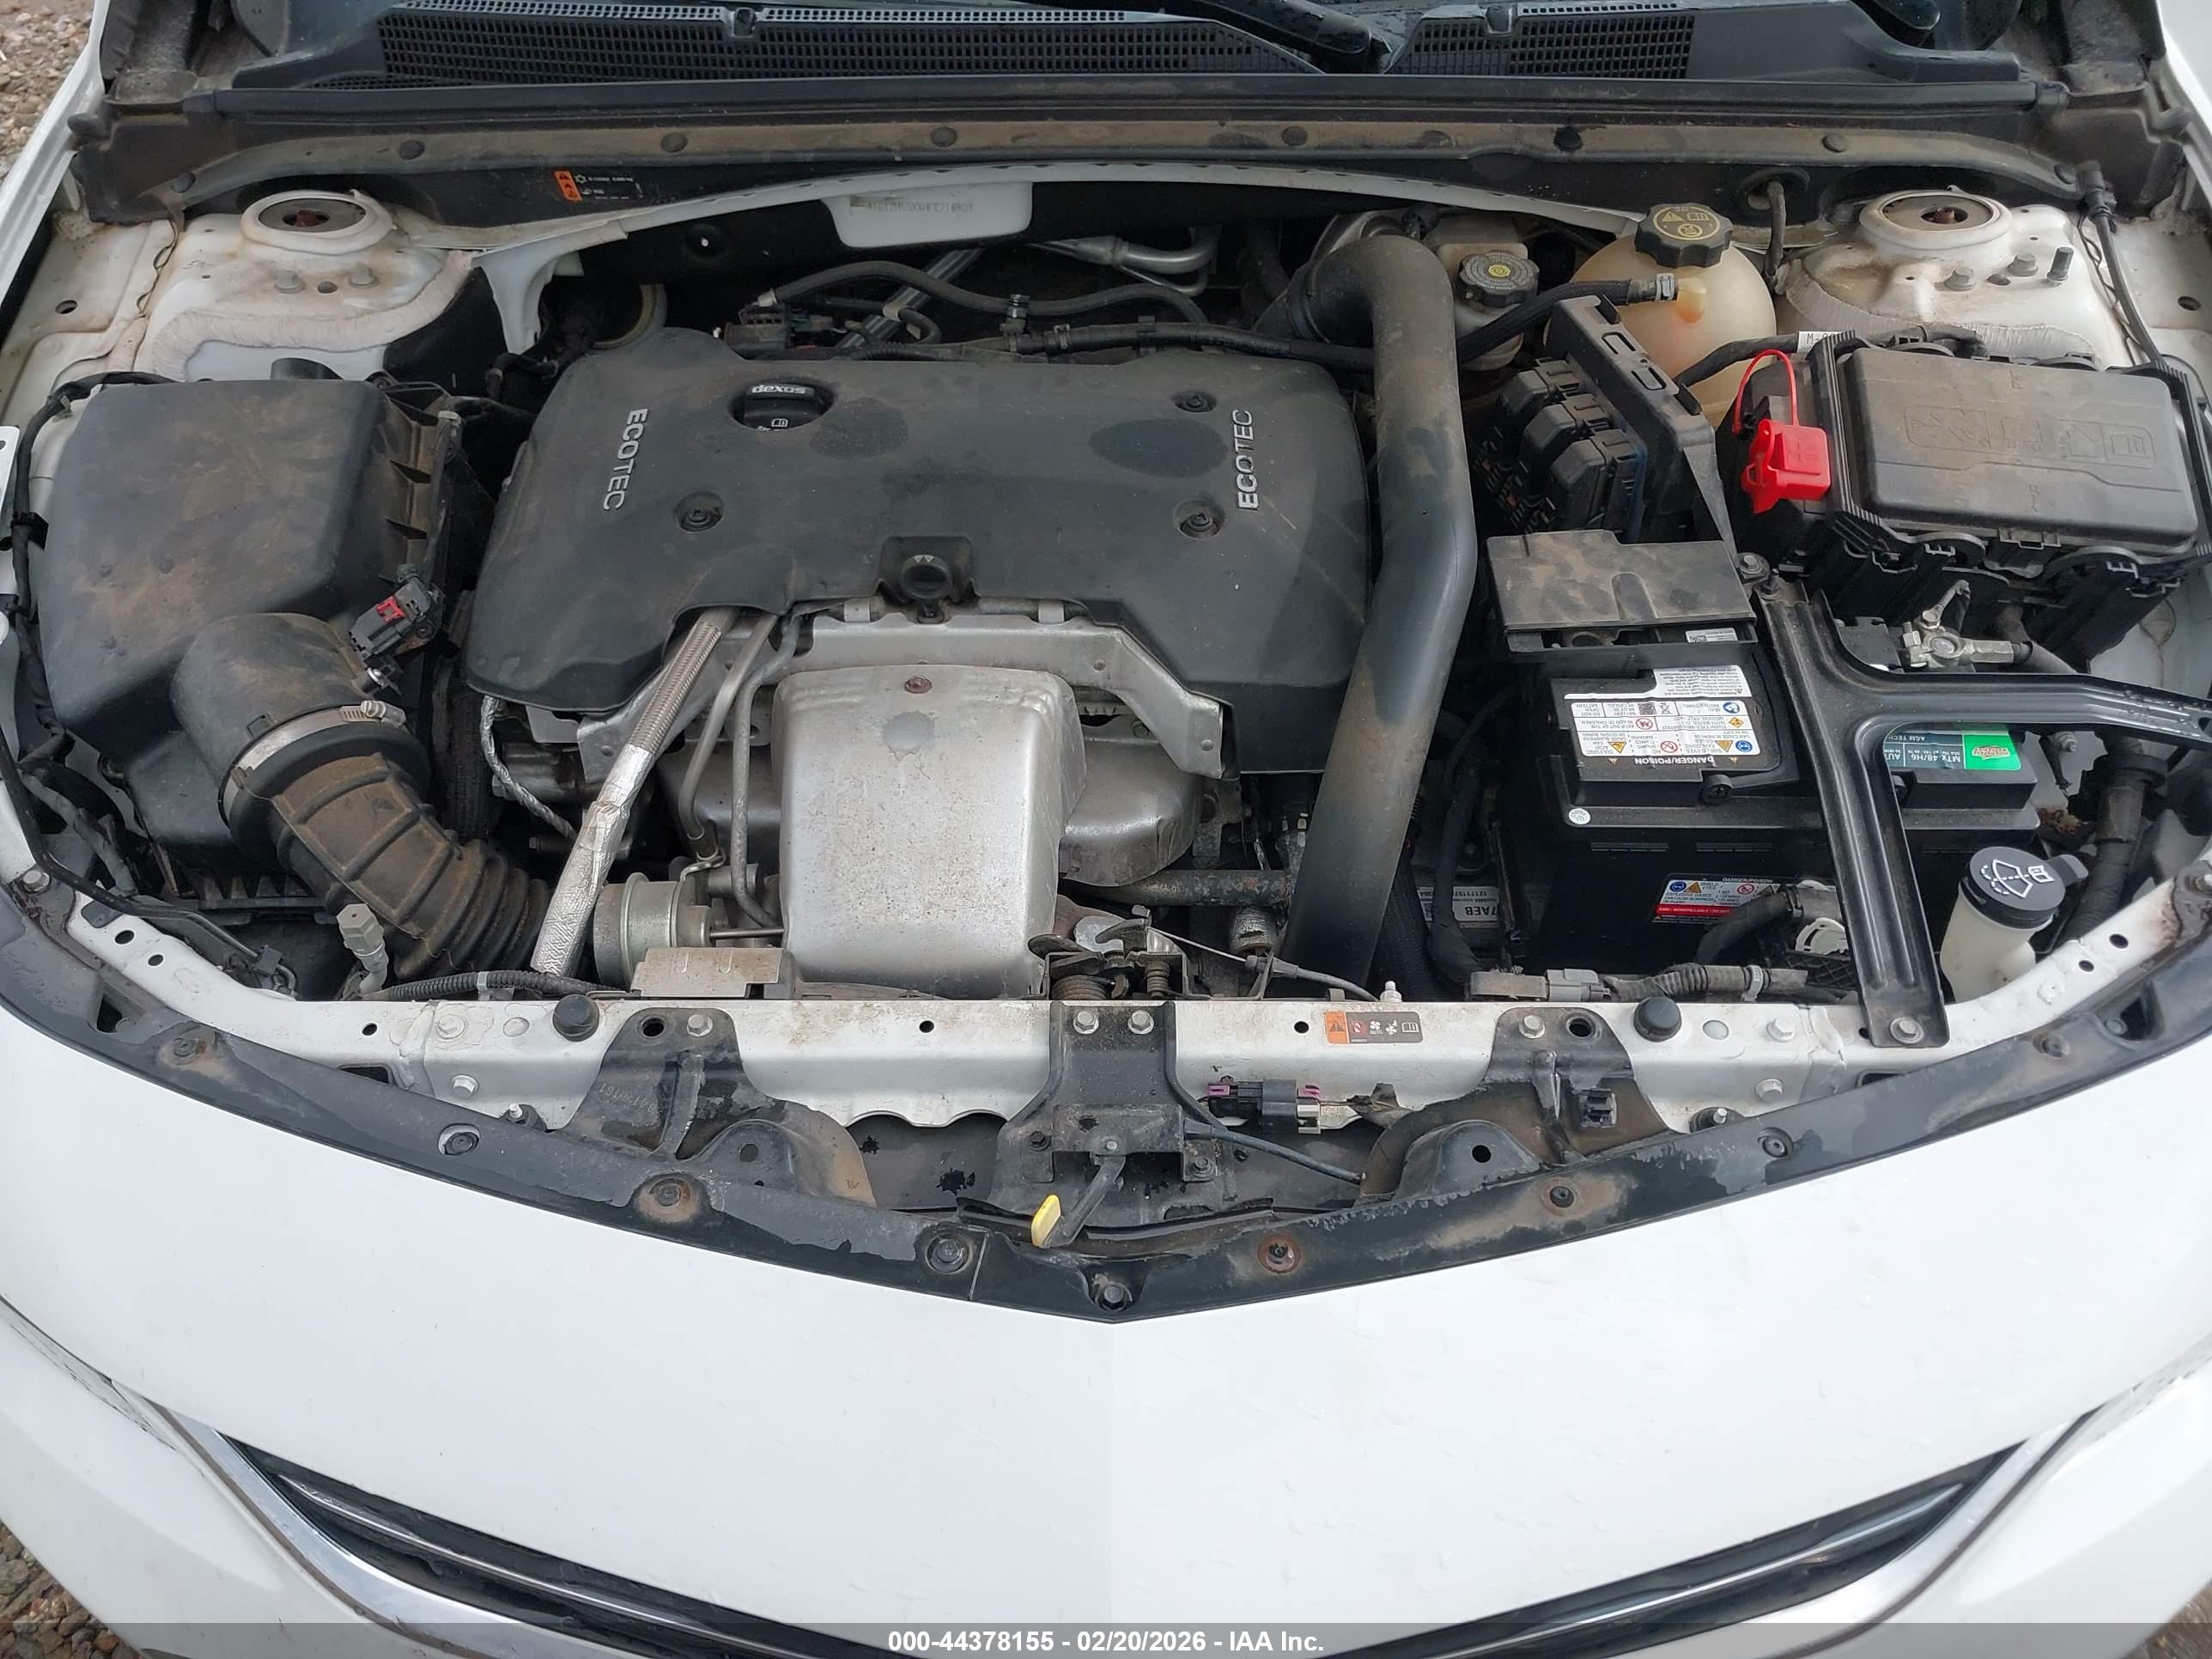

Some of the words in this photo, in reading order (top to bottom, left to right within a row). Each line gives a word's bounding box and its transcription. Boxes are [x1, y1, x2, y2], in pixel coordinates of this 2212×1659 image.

[751, 384, 805, 394] dexos
[603, 409, 648, 510] ECOTEC
[1232, 410, 1259, 509] ECOTEC
[1634, 756, 1714, 765] DANGER/POISON
